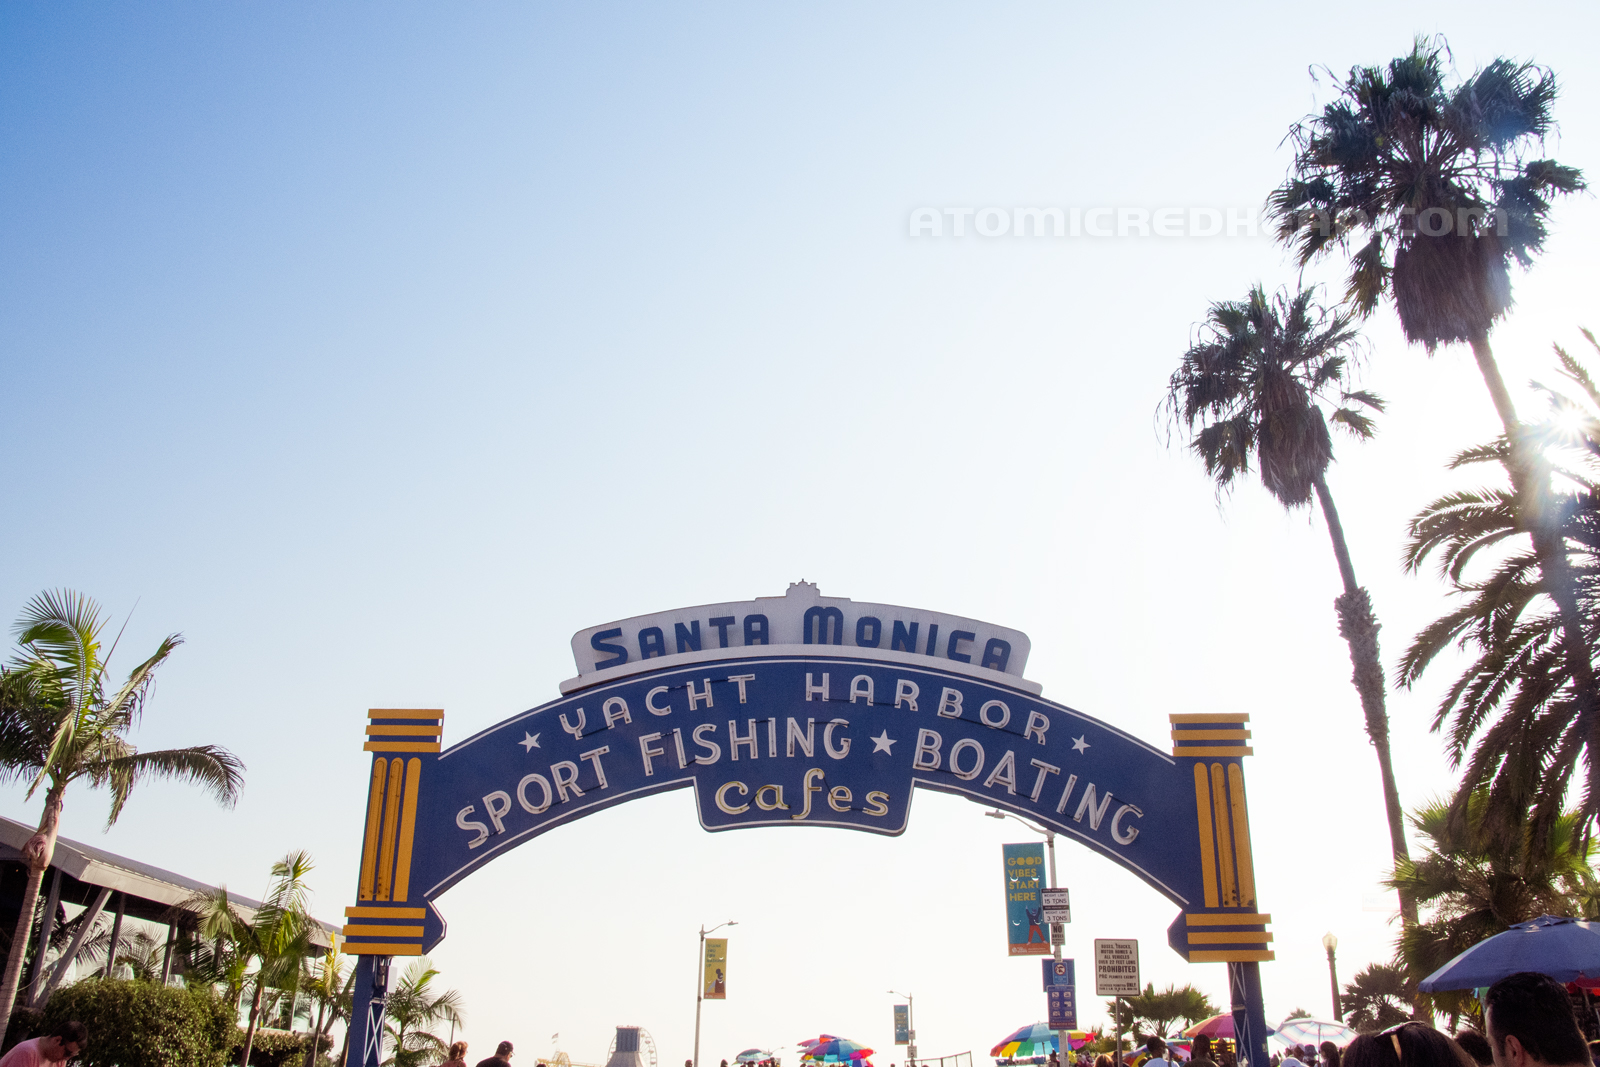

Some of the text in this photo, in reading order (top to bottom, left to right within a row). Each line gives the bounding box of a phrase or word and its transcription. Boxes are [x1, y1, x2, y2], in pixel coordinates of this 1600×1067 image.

[590, 606, 1012, 671] SANTA MONICA
[559, 672, 1051, 746] YACHT HARBOR
[456, 717, 1144, 850] SPORT FISHING BOATING
[715, 767, 890, 820] cafes
[1007, 856, 1042, 866] GOOD
[1008, 868, 1037, 878] VIBES
[1009, 880, 1040, 890] START
[1009, 892, 1037, 902] HERE
